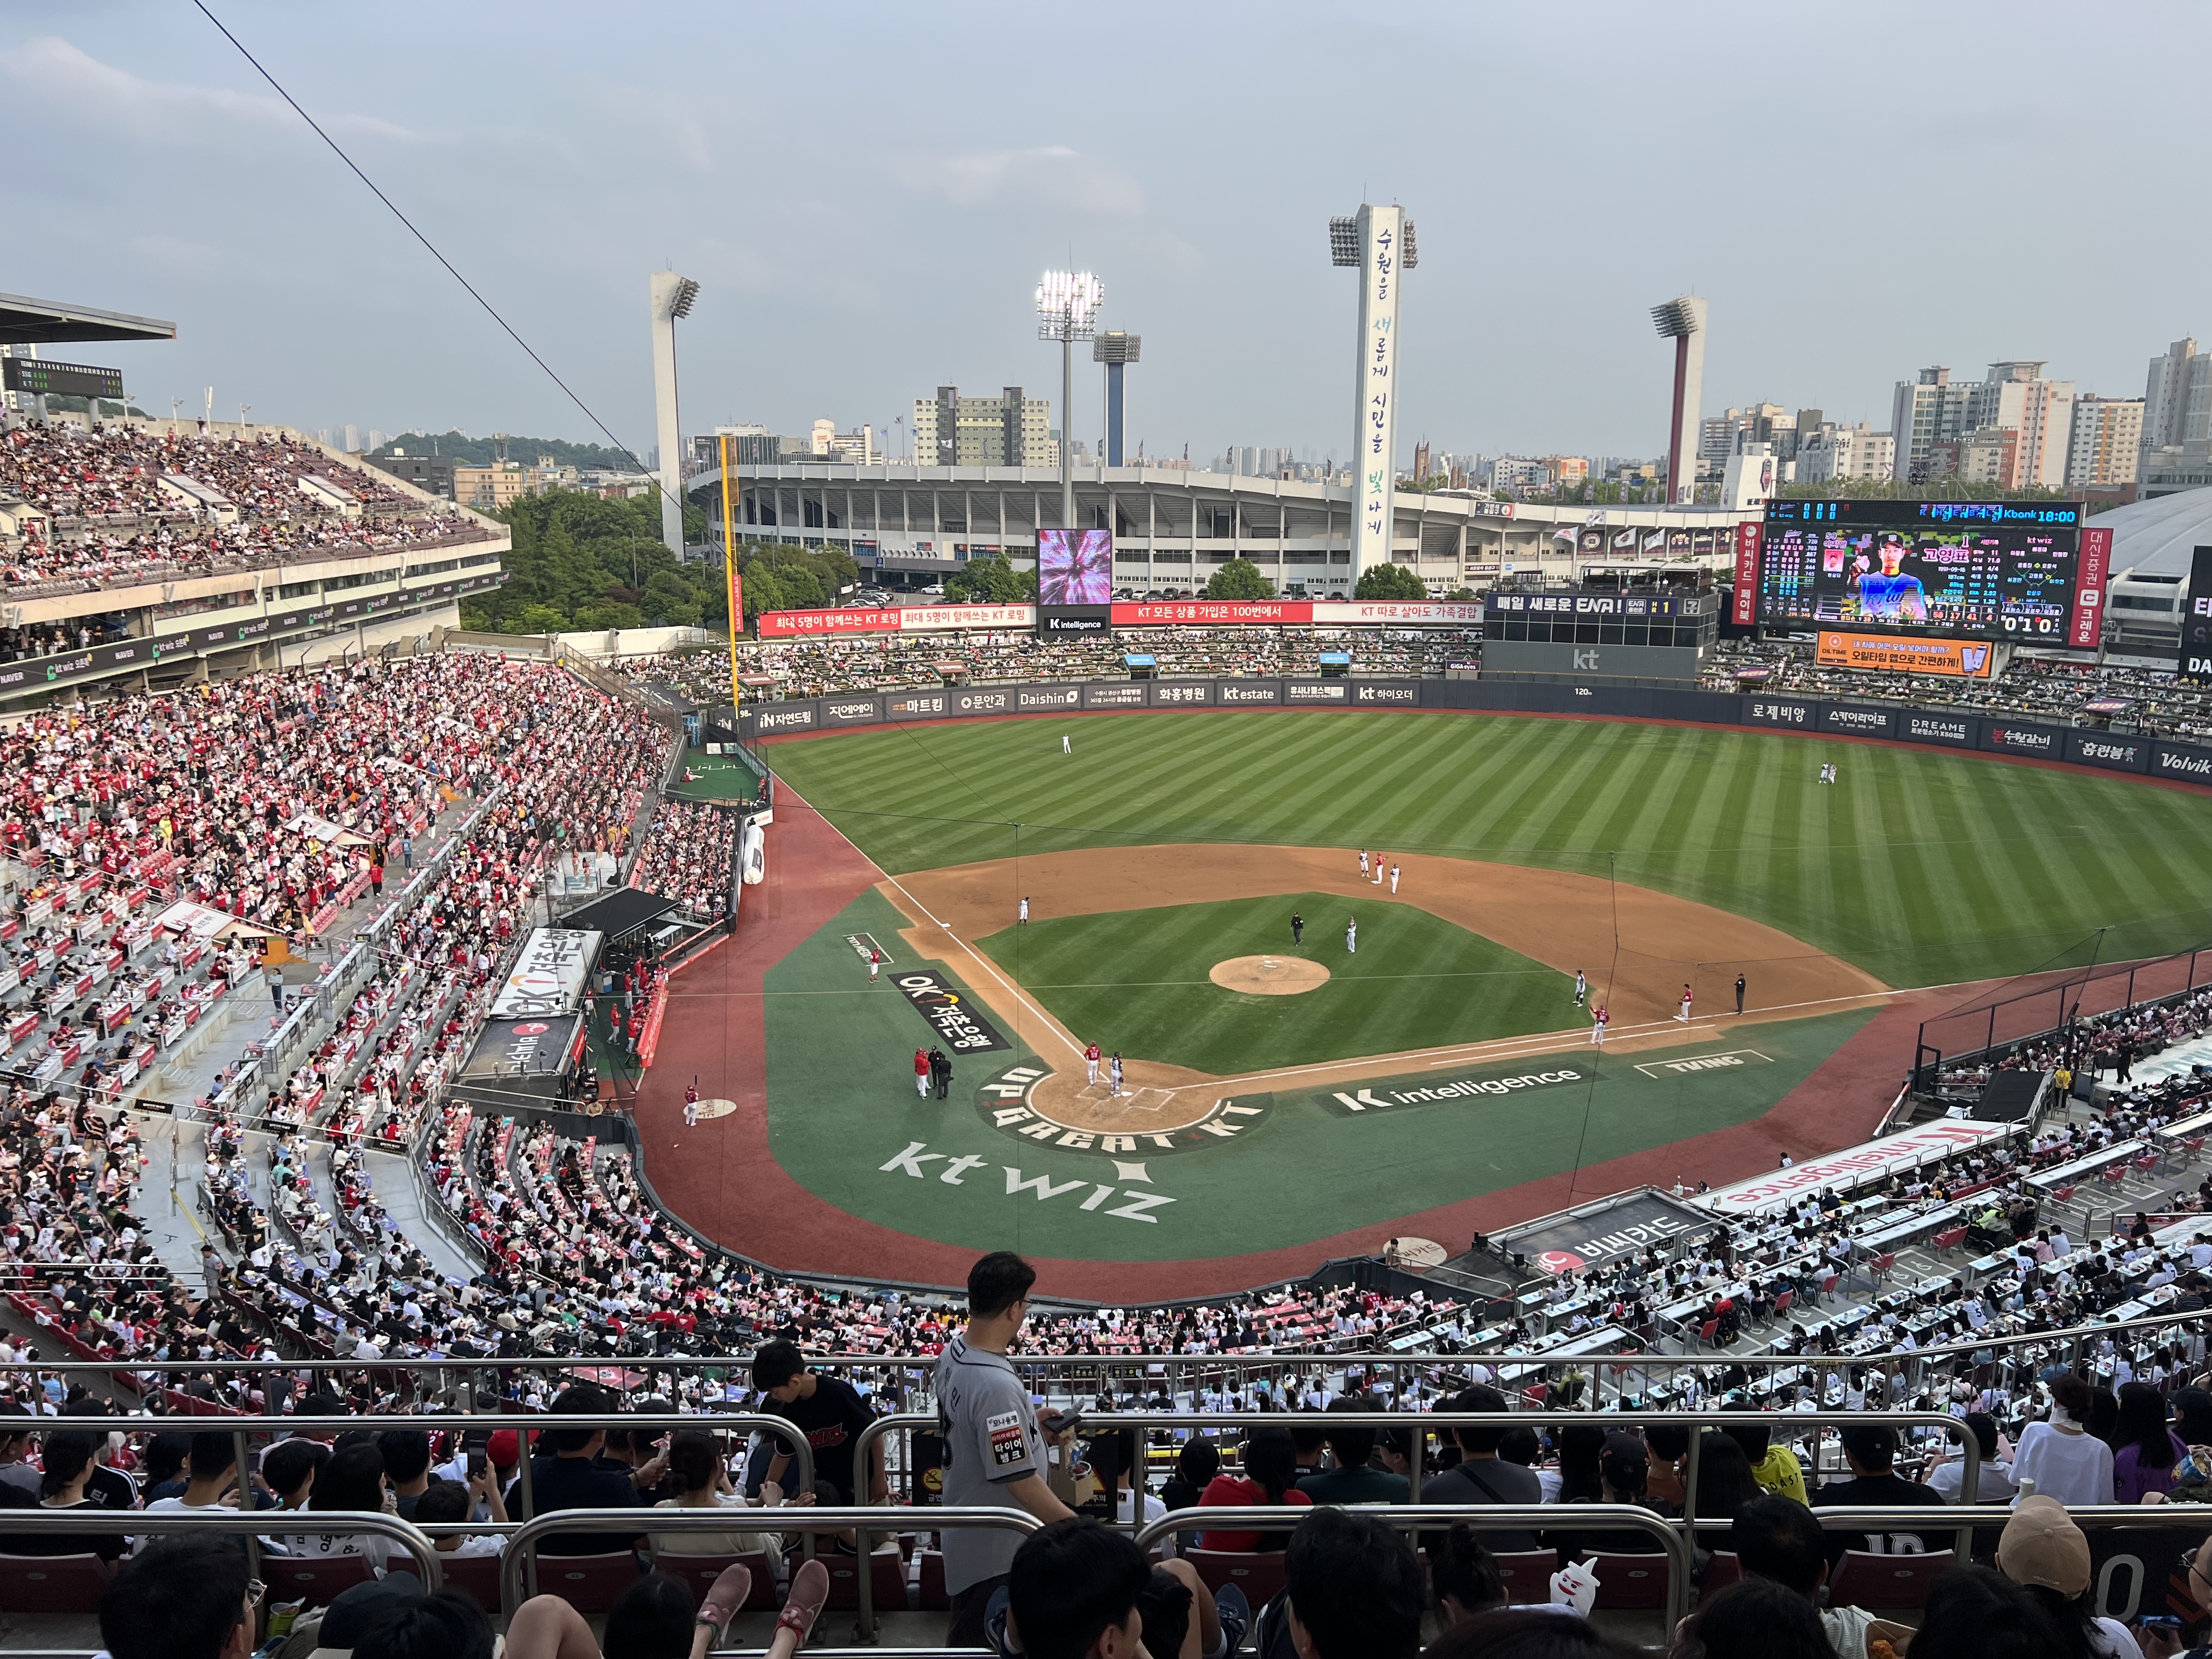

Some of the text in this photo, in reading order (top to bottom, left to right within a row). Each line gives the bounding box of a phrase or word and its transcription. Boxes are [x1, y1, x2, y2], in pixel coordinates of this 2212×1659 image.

[1367, 228, 1392, 535] 수원을 새롭게 시민을 빛나게
[2005, 510, 2036, 519] Kbank
[2038, 511, 2075, 522] 18:00
[1824, 540, 1847, 549] 이지영
[1961, 535, 1970, 548] 1
[1921, 548, 1970, 563] 고영표
[1739, 539, 1754, 621] 비씨카드 페이북
[2078, 532, 2103, 642] 대신증권 크레온
[1138, 606, 1282, 618] KT 모든 상품 가입은 100번에서
[1497, 596, 1524, 610] 매일
[1528, 597, 1572, 612] 새로운
[776, 612, 899, 629] 최대 5명이 함께쓰는 KT 로밍
[905, 610, 1025, 623] 최대 5명이 함께쓰는 KT 로밍
[1362, 607, 1477, 619] KT 따로 살아도 가족결합
[1050, 618, 1102, 630] K intelligence
[2005, 617, 2051, 634] 0 1 0
[1877, 641, 1891, 650] 어떤
[1892, 643, 1906, 651] 오일
[115, 650, 134, 659] NAVER
[1573, 648, 1600, 670] kt
[1852, 651, 1959, 668] 오일타임 앱으로 간편하게!
[0, 672, 24, 684] NAVER
[973, 693, 1006, 710] 문안과
[1020, 692, 1064, 706] Daishin
[1159, 688, 1205, 701] 화홍병원
[1223, 687, 1274, 700] kt estate
[1359, 687, 1413, 700] kt 하이오더
[829, 703, 873, 719] 지에에이
[906, 698, 943, 713] 마트킹
[1752, 703, 1806, 723] 로제비앙
[776, 710, 811, 726] 자연드림
[1829, 710, 1887, 725] 스카이라이프
[1911, 719, 1966, 733] DREAME
[1911, 727, 1939, 737] 로봇청소기
[2082, 741, 2124, 759] 홈런볼
[2160, 752, 2211, 775] Volvik
[528, 929, 587, 975] 저축은행
[930, 1005, 992, 1048] 저축은행
[1665, 1055, 1745, 1073] TVING
[1332, 1068, 1583, 1111] K intelligence
[992, 1107, 1175, 1153] GREAT
[1199, 1101, 1265, 1136] KT
[1726, 1126, 1997, 1203] K intelligence
[878, 1142, 1177, 1223] kt wiz
[1537, 1216, 1690, 1272] 비씨카드 BC
[993, 1415, 1017, 1426] 모나용평
[995, 1437, 1022, 1453] 타이어
[1000, 1451, 1022, 1463] 뱅크
